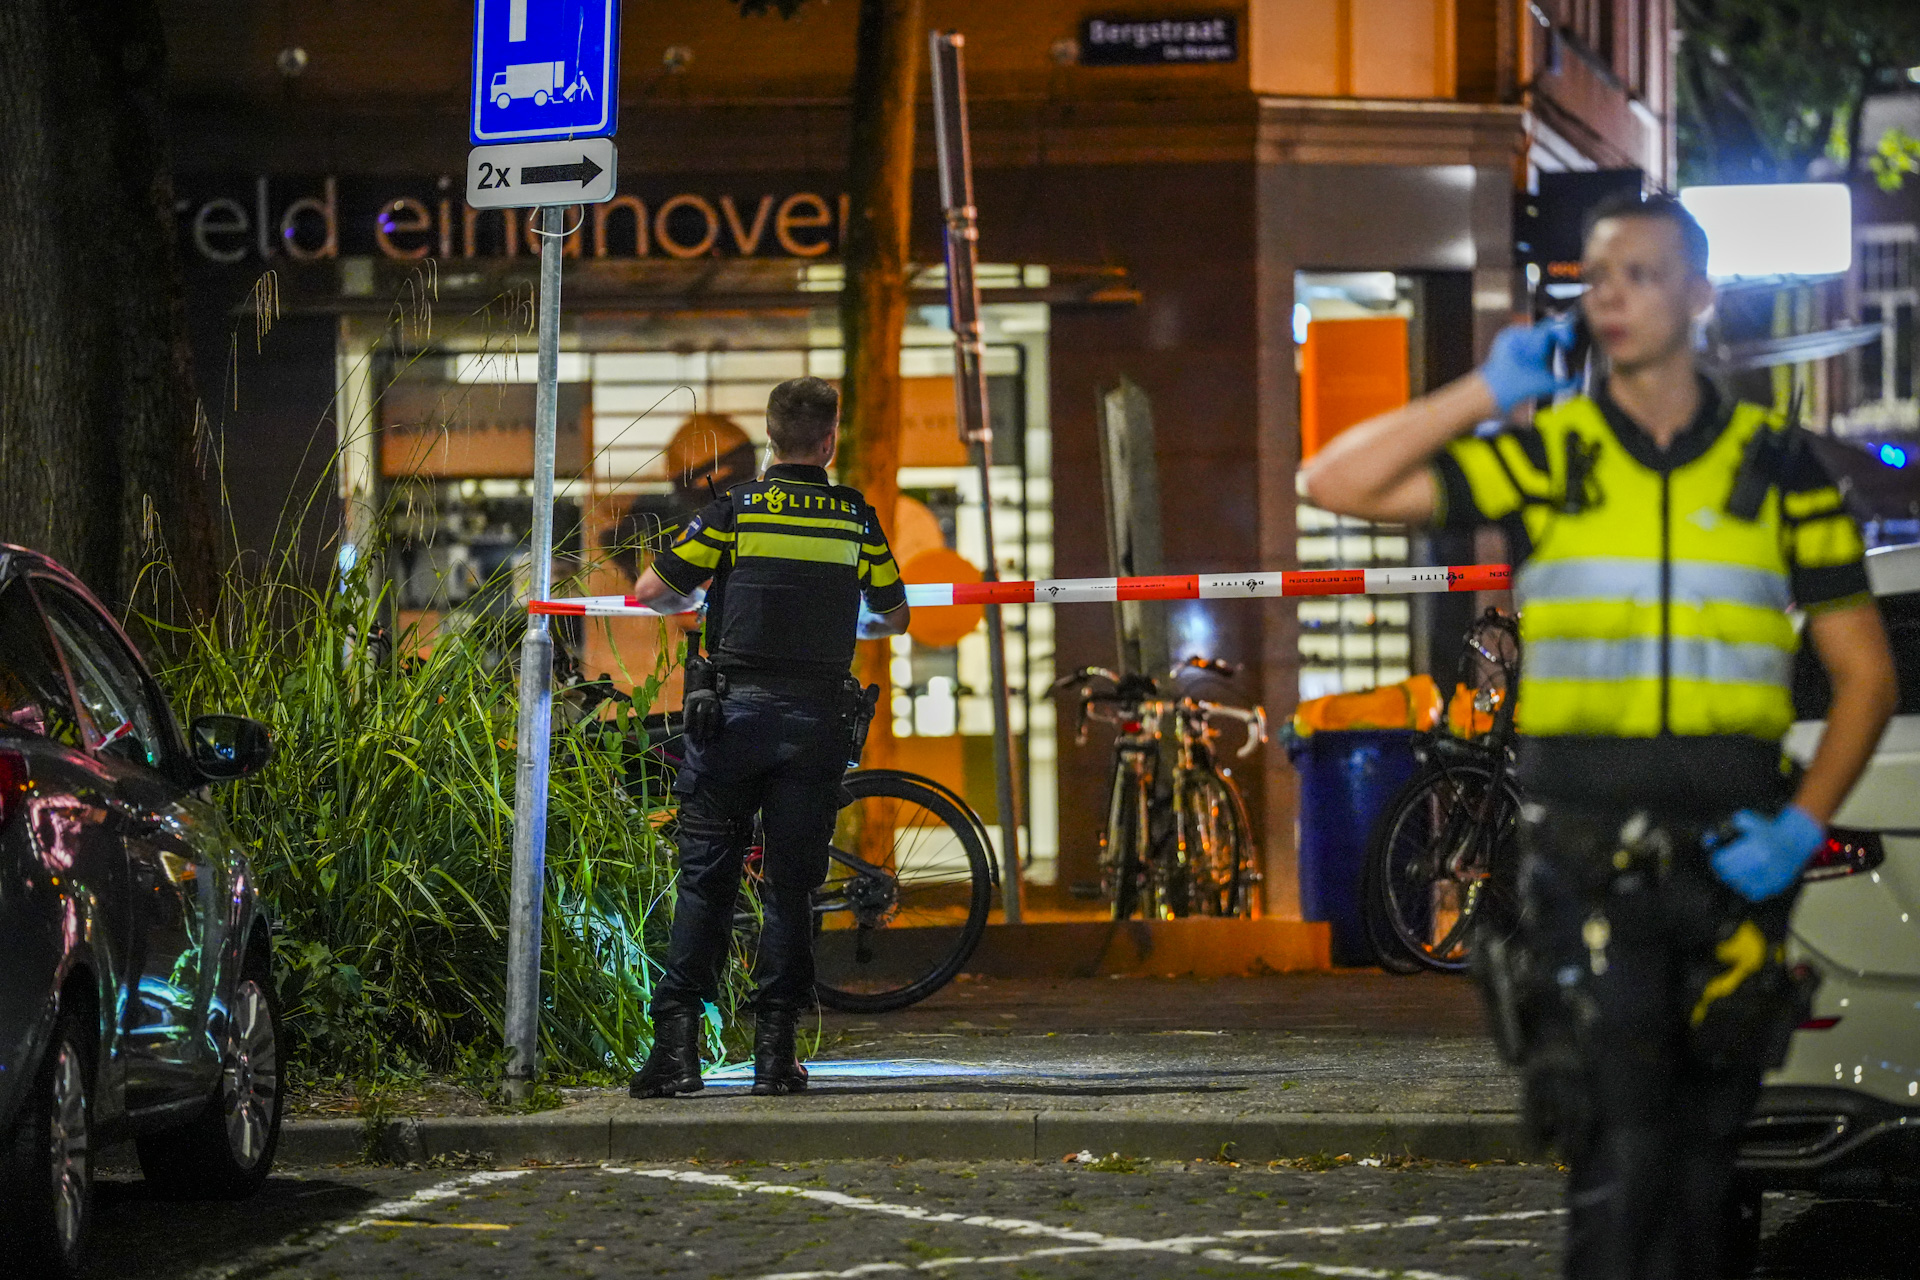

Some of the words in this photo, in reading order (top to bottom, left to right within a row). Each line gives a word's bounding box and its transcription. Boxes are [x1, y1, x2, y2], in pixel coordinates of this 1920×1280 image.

[1090, 19, 1225, 48] Bergstraat
[477, 162, 511, 190] 2x
[178, 176, 338, 262] eld
[752, 486, 851, 513] POLITIE
[1411, 572, 1465, 586] POLITIE
